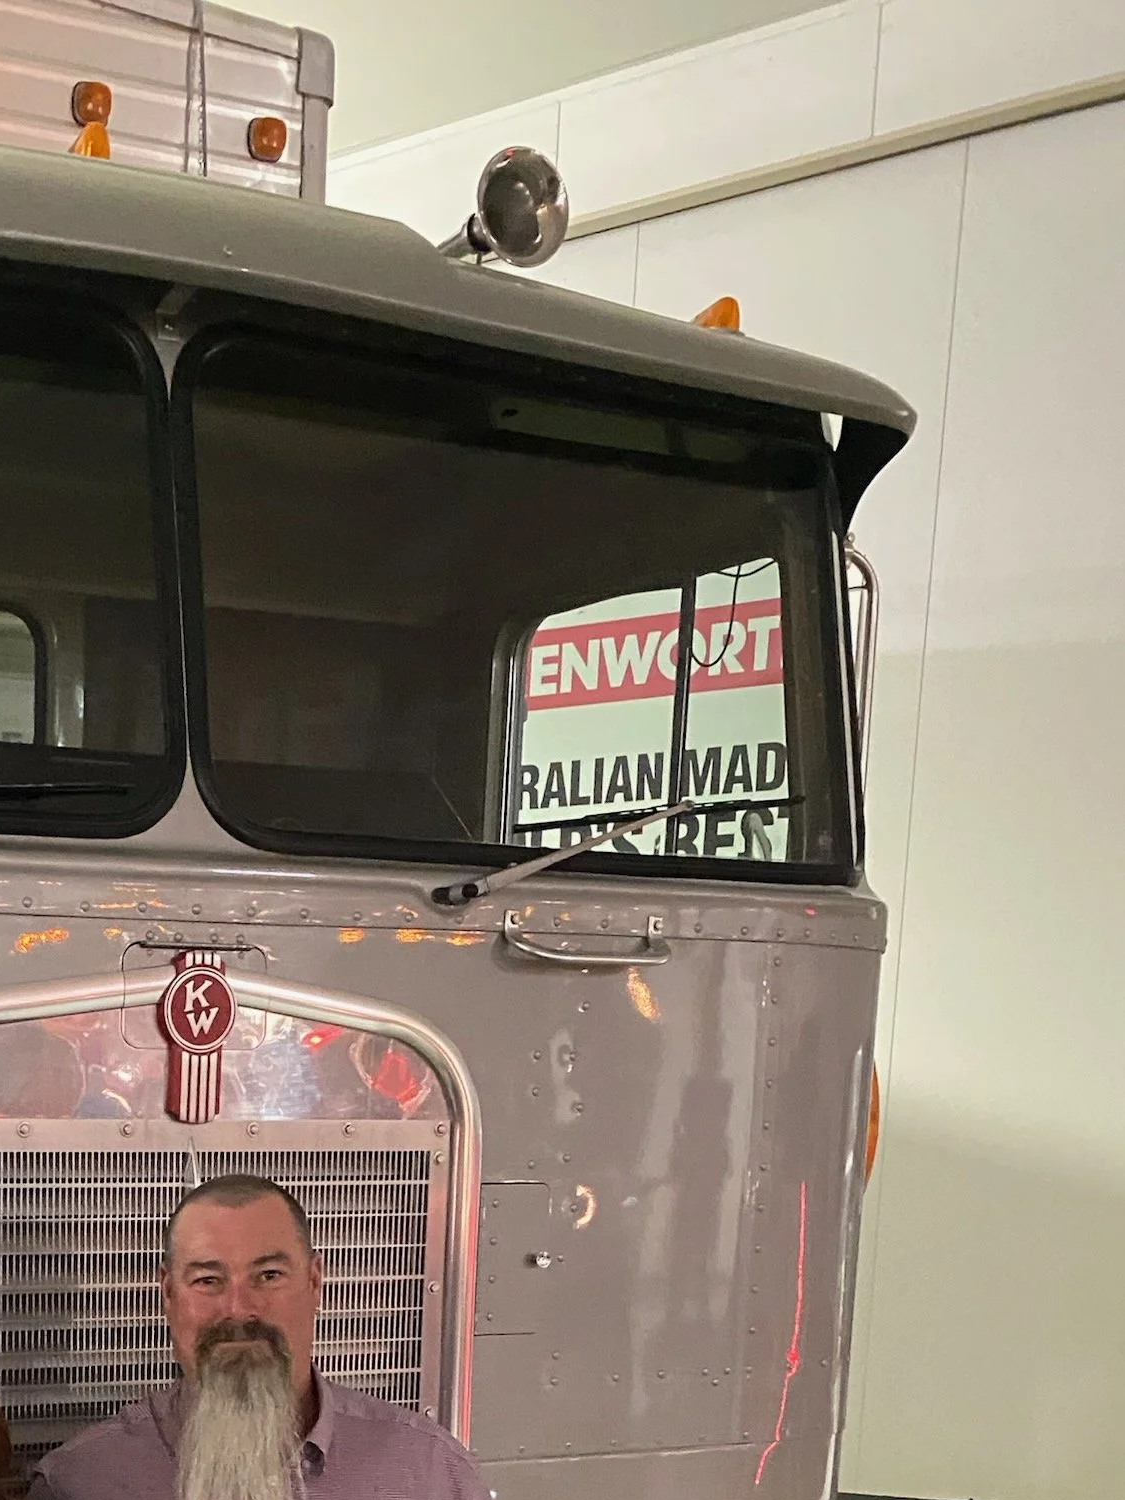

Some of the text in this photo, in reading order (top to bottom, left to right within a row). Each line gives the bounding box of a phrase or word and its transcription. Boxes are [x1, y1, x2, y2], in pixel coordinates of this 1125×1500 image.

[529, 615, 782, 697] ENWORT
[521, 741, 788, 810] RALIAN MAD
